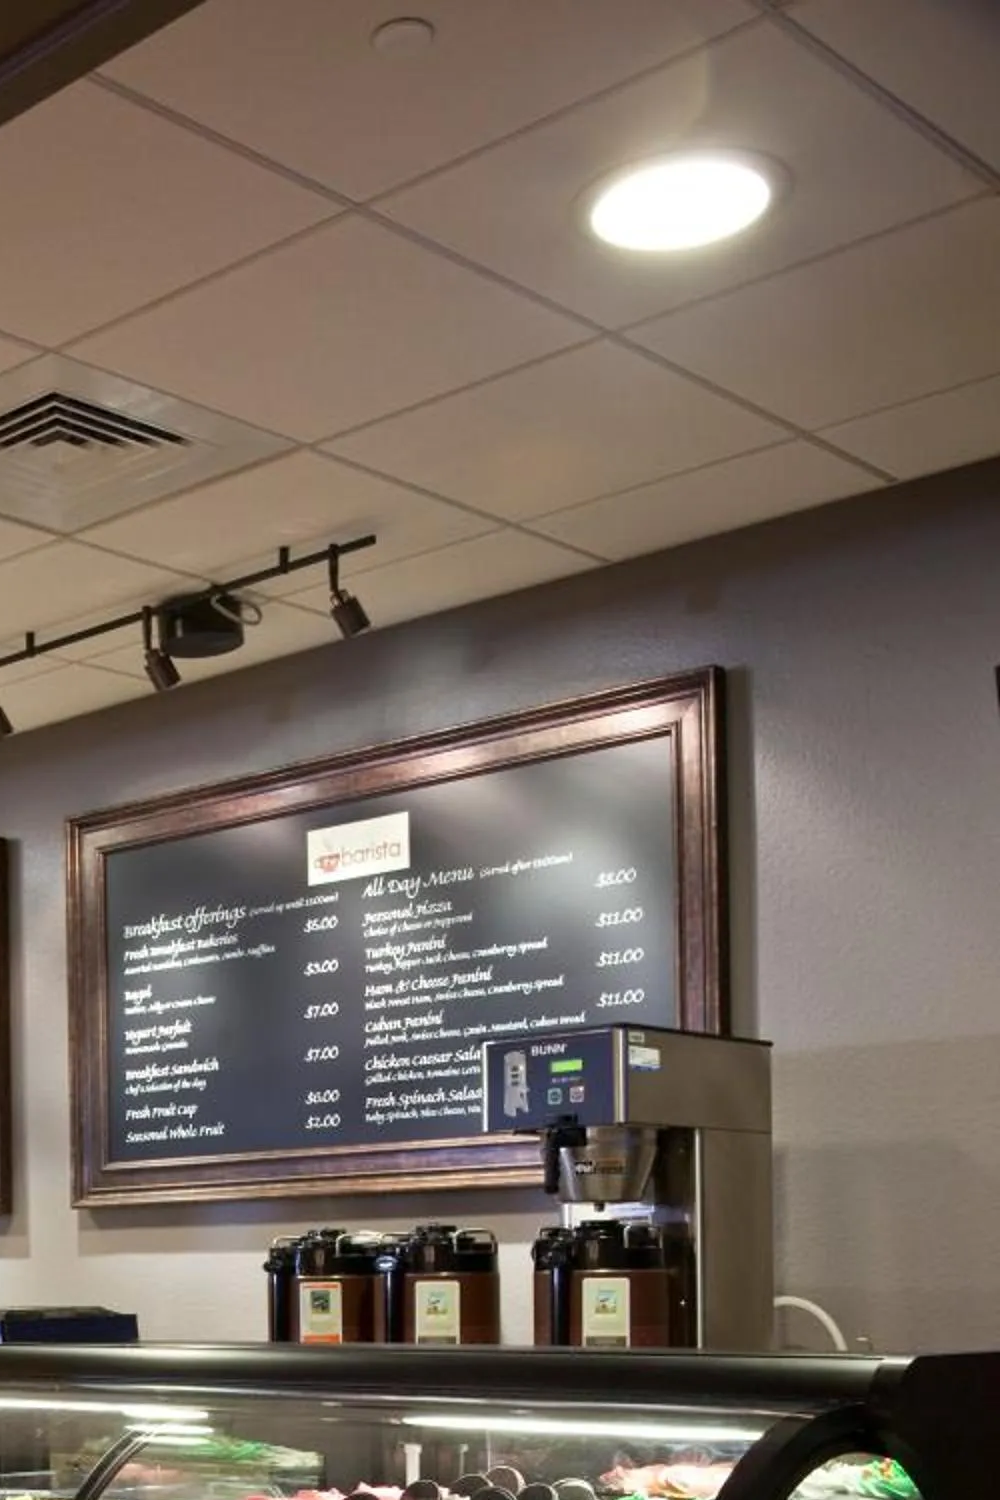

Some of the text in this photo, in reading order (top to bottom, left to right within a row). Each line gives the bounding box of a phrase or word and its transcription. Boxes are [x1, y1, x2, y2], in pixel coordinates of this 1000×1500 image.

[341, 841, 402, 866] barista
[361, 876, 385, 900] All
[387, 877, 421, 899] Day
[422, 867, 475, 889] Menu
[123, 913, 183, 939] Breakfast
[303, 1002, 339, 1019] $7.00
[364, 1014, 402, 1034] Cuban
[303, 1045, 340, 1062] $7.00
[364, 1045, 482, 1071] Chicken Caesar Sala
[531, 1043, 567, 1057] BUNN
[365, 1091, 396, 1109] Fresh
[395, 1087, 445, 1111] Spinach
[126, 1104, 151, 1121] Fresh
[151, 1101, 178, 1119] Fruit
[126, 1120, 226, 1143] Seasonal Whole Fruit
